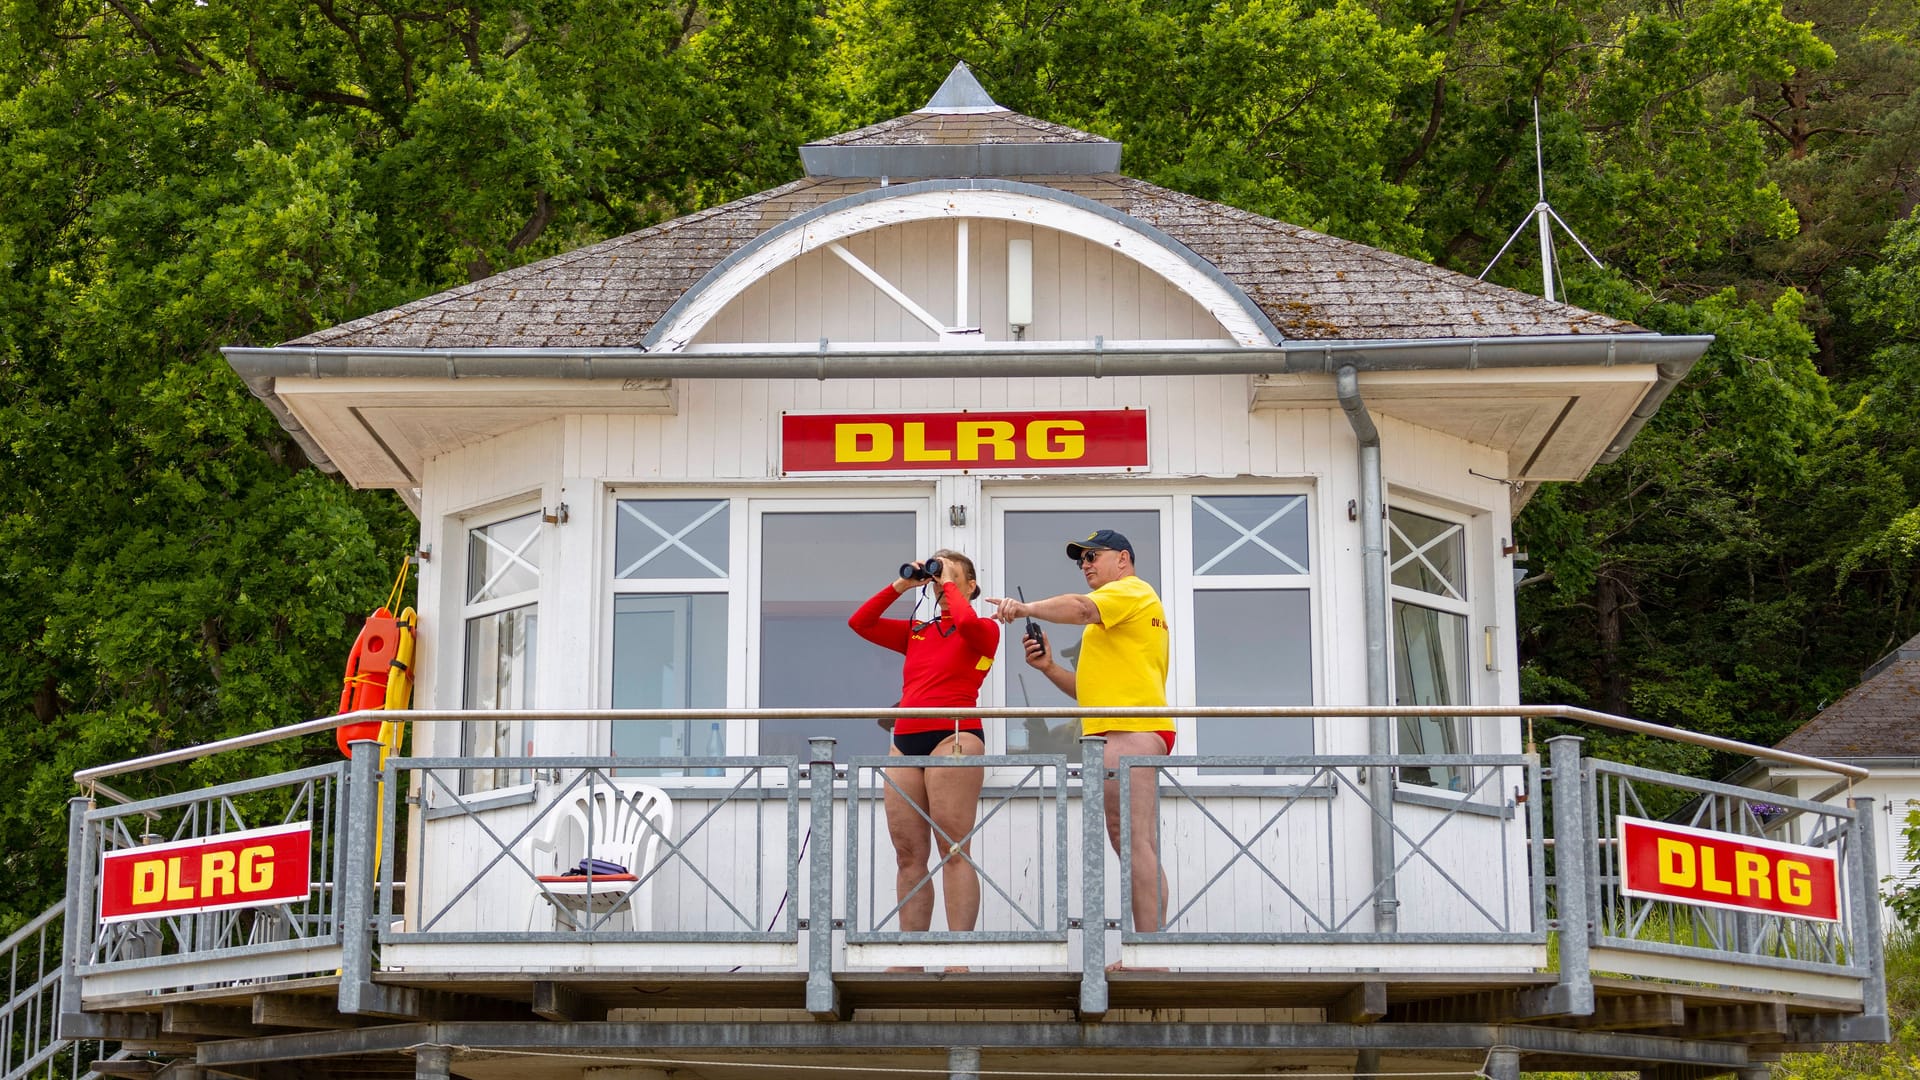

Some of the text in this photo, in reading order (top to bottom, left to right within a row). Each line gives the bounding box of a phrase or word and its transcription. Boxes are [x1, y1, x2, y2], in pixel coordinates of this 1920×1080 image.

[835, 420, 1085, 463] DLRG
[132, 845, 275, 906] DLRG
[1657, 837, 1812, 907] DLRG
